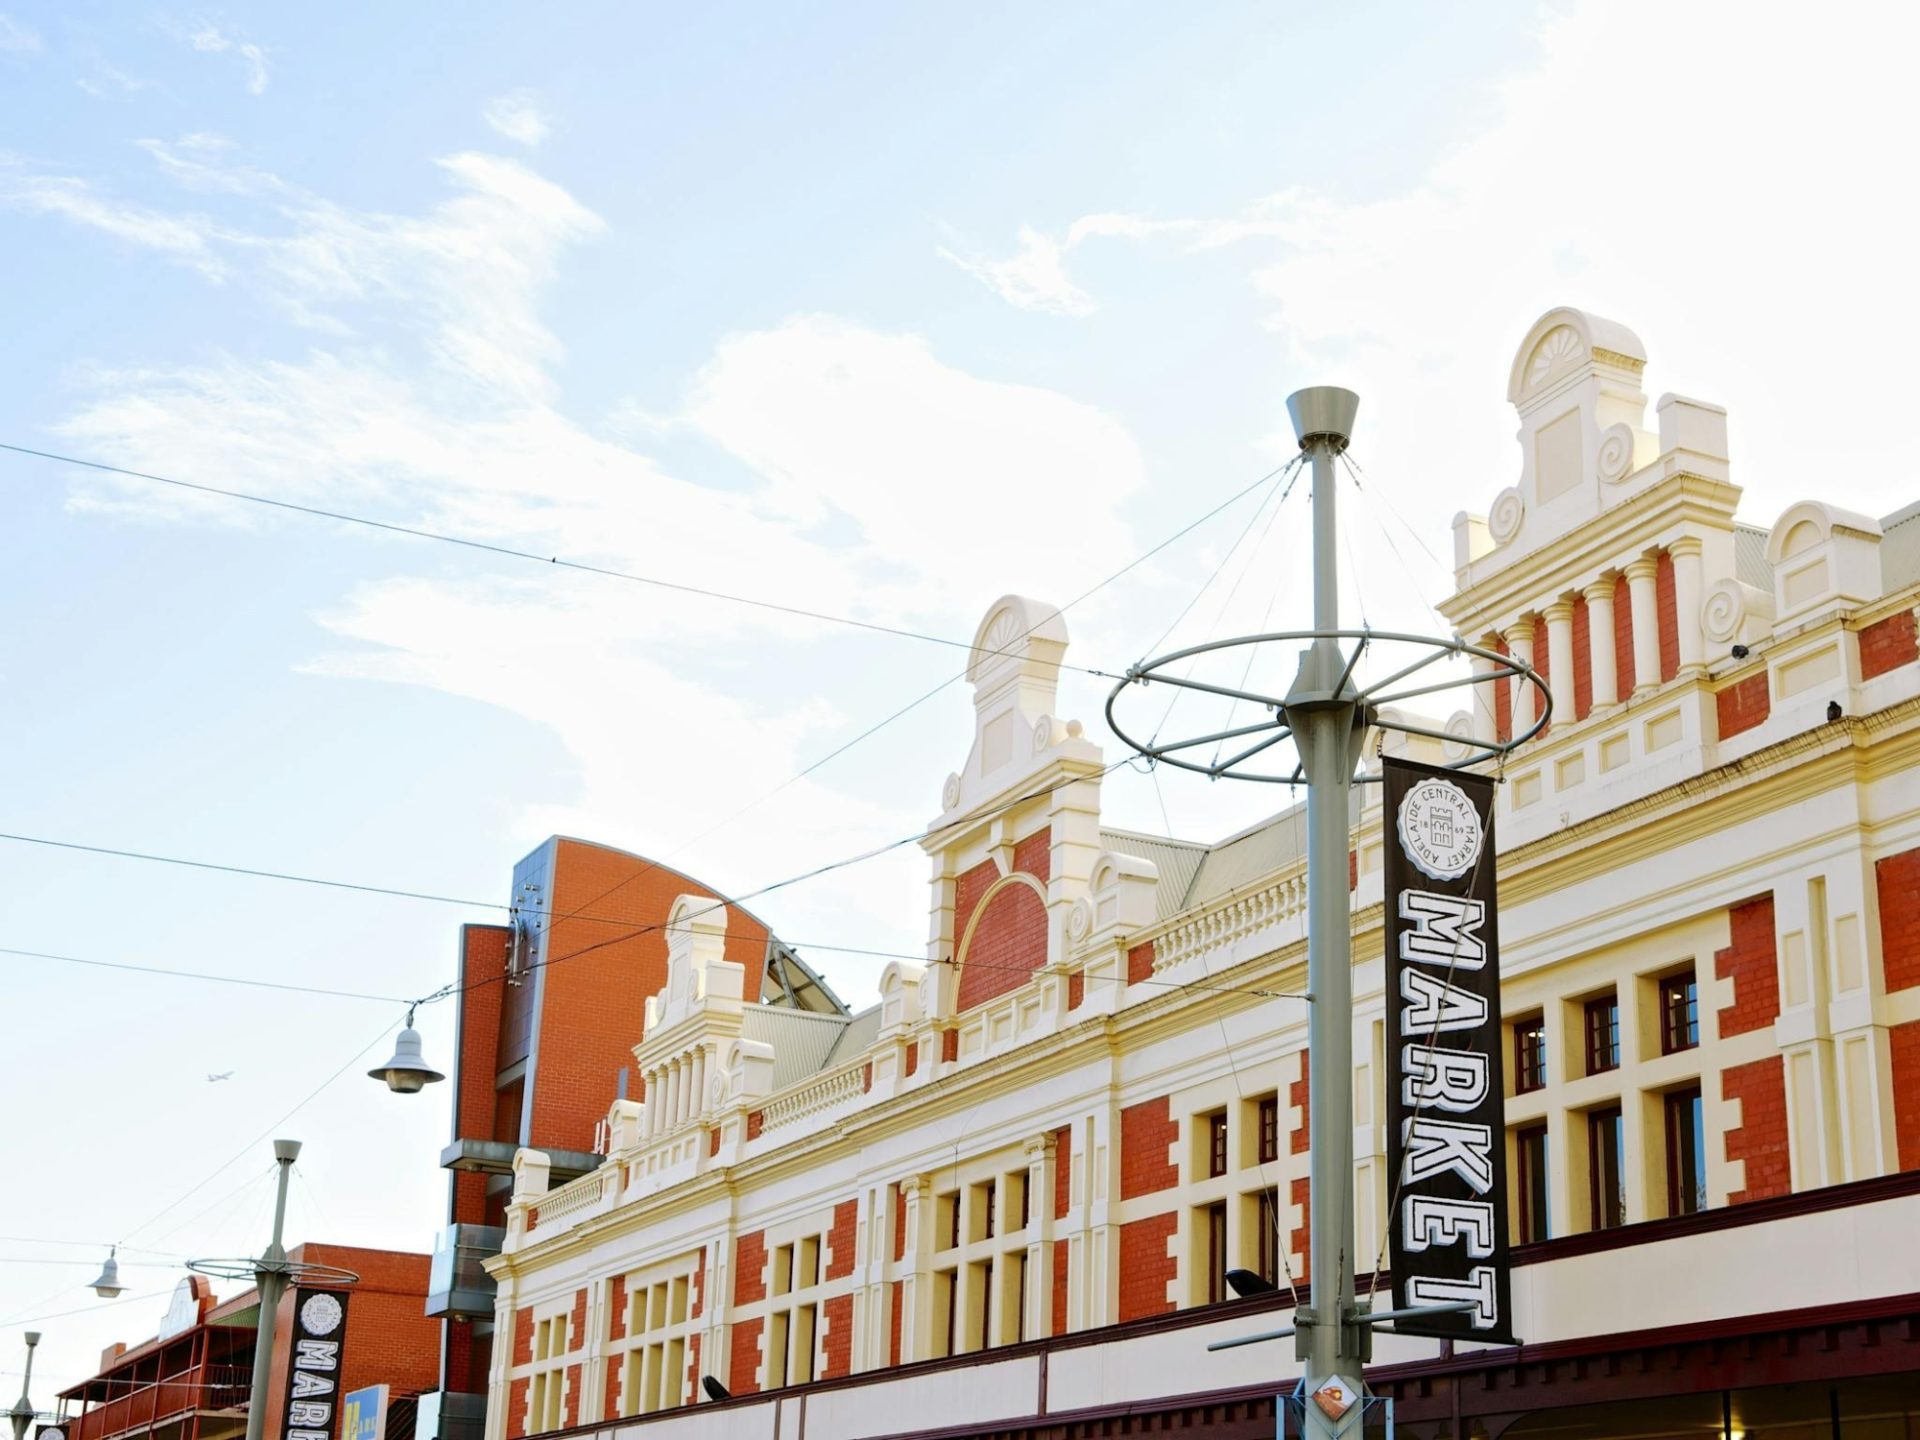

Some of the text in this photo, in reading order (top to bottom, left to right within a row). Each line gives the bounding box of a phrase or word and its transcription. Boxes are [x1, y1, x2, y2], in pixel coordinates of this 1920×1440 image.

[1409, 788, 1475, 867] ADELAIDE CENTRAL MARKET
[1399, 889, 1498, 1329] MARKET
